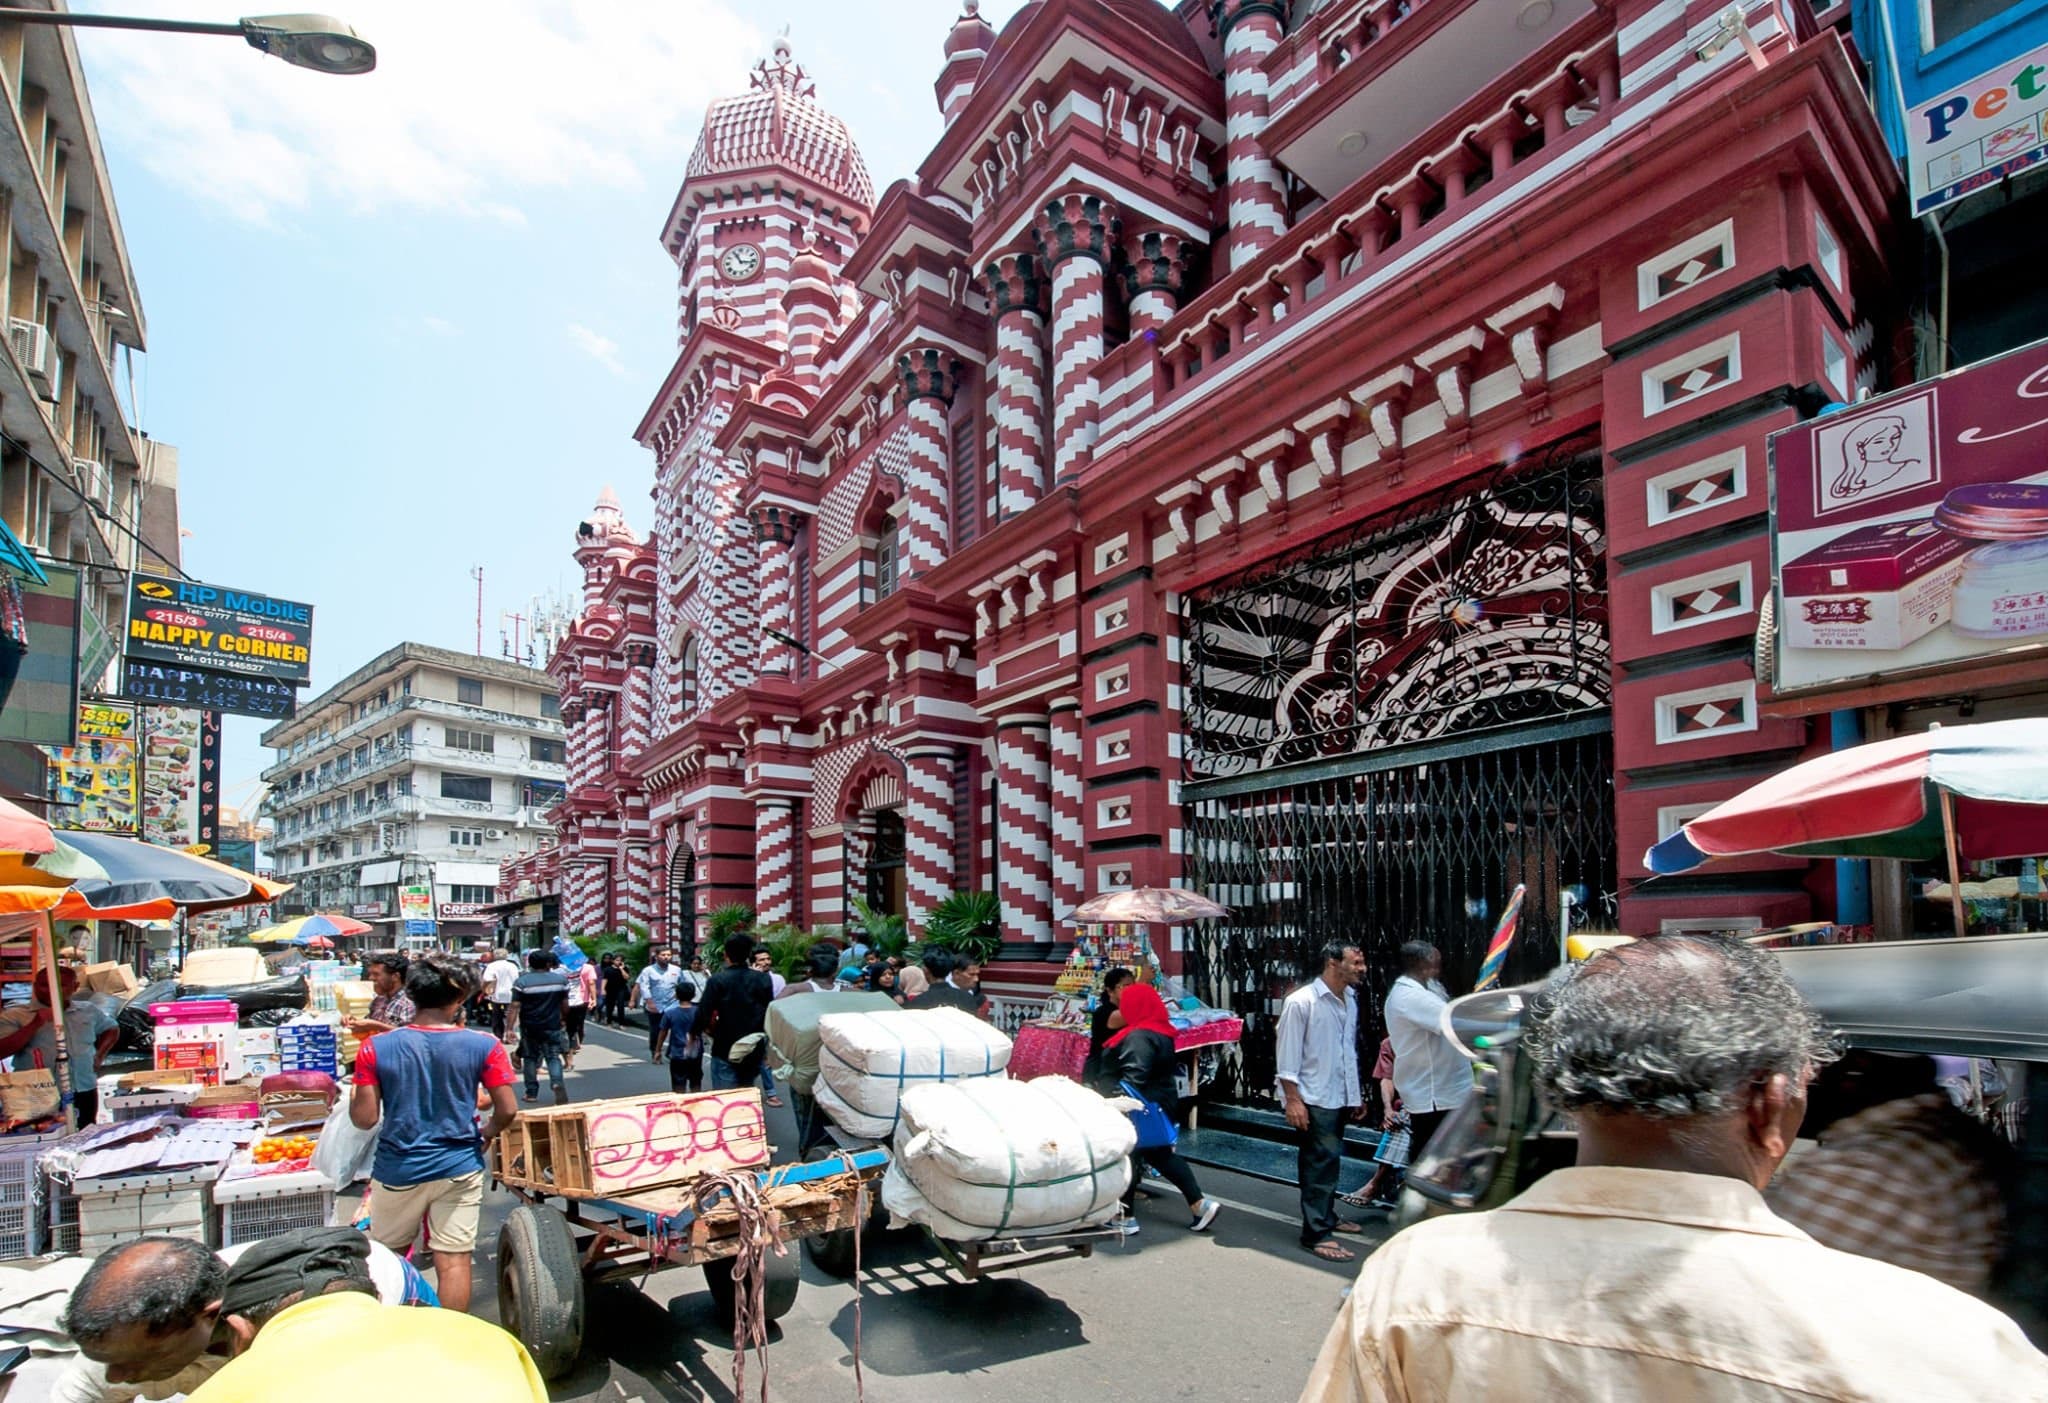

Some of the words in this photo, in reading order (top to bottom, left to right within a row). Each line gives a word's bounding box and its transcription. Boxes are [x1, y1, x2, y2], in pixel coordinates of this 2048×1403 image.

[1923, 64, 2047, 144] Pet
[178, 583, 217, 605] HP
[224, 591, 308, 623] Mobile
[186, 607, 203, 617] Tel:
[204, 611, 231, 621] 07777
[156, 610, 198, 627] 215/3
[130, 619, 214, 649] HAPPY
[218, 634, 308, 664] CORNER
[248, 626, 287, 642] 215/4
[176, 652, 198, 663] Tel:
[200, 656, 225, 668] 0112
[227, 660, 264, 673] 445527
[129, 663, 208, 686] HAPPY
[215, 677, 293, 697] CORNER
[128, 680, 188, 702] 0112
[197, 690, 241, 708] 445
[248, 697, 290, 714] 527
[81, 709, 130, 724] SSIC
